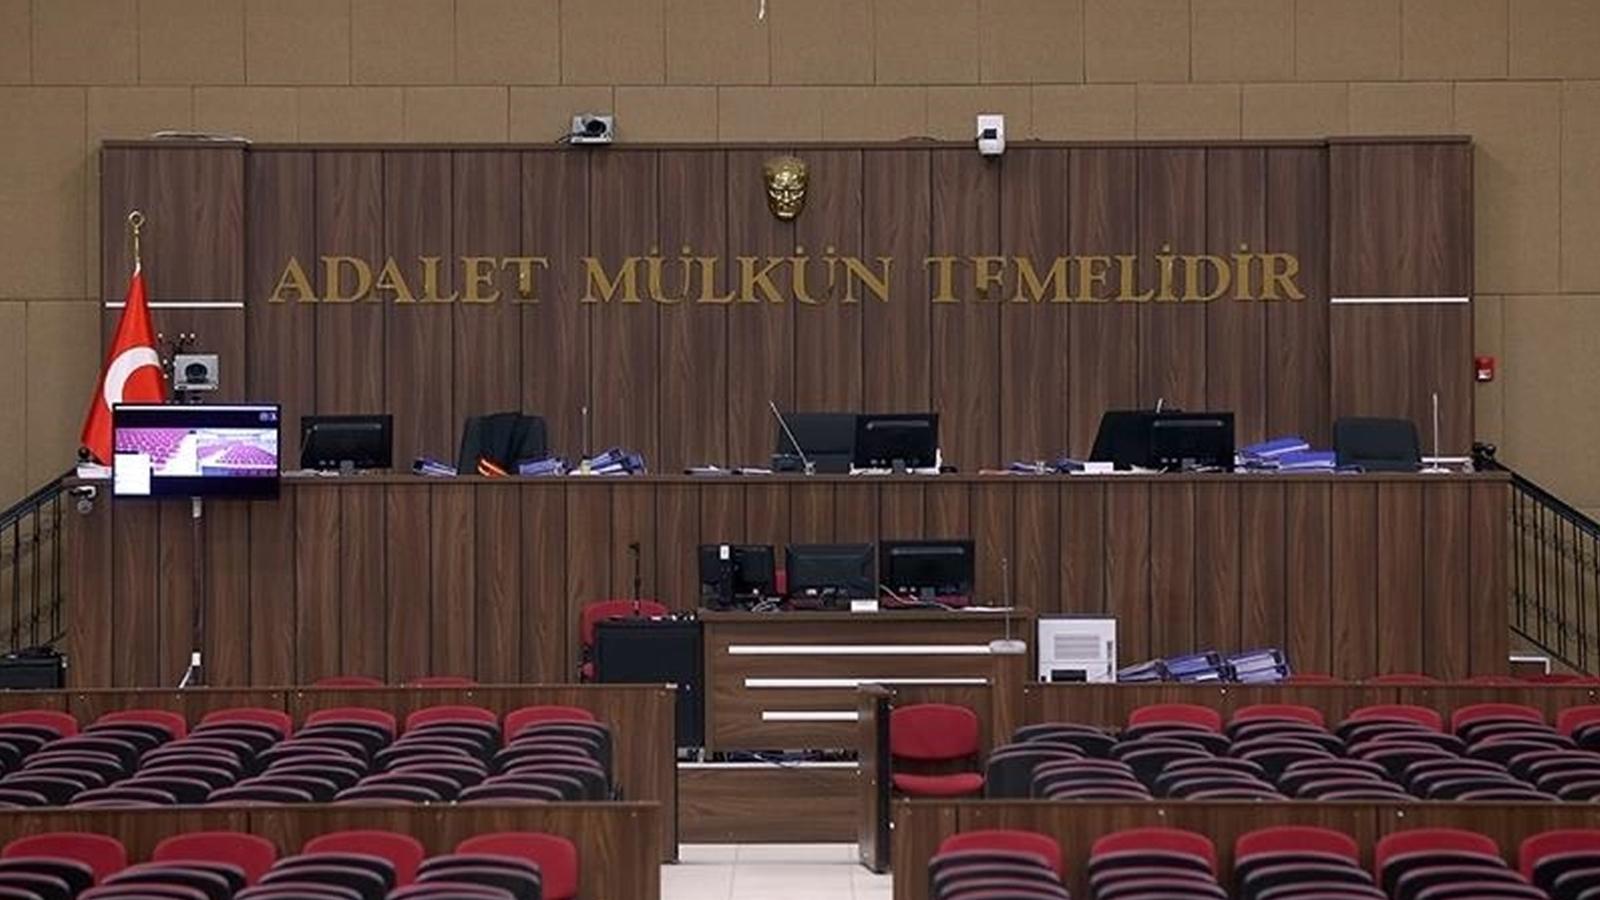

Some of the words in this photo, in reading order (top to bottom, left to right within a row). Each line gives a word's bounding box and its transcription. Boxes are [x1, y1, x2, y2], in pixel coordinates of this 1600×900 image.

[268, 255, 548, 304] ADALET
[582, 245, 892, 304] MÜLKÜN
[925, 244, 1306, 304] TEMELİDİR
